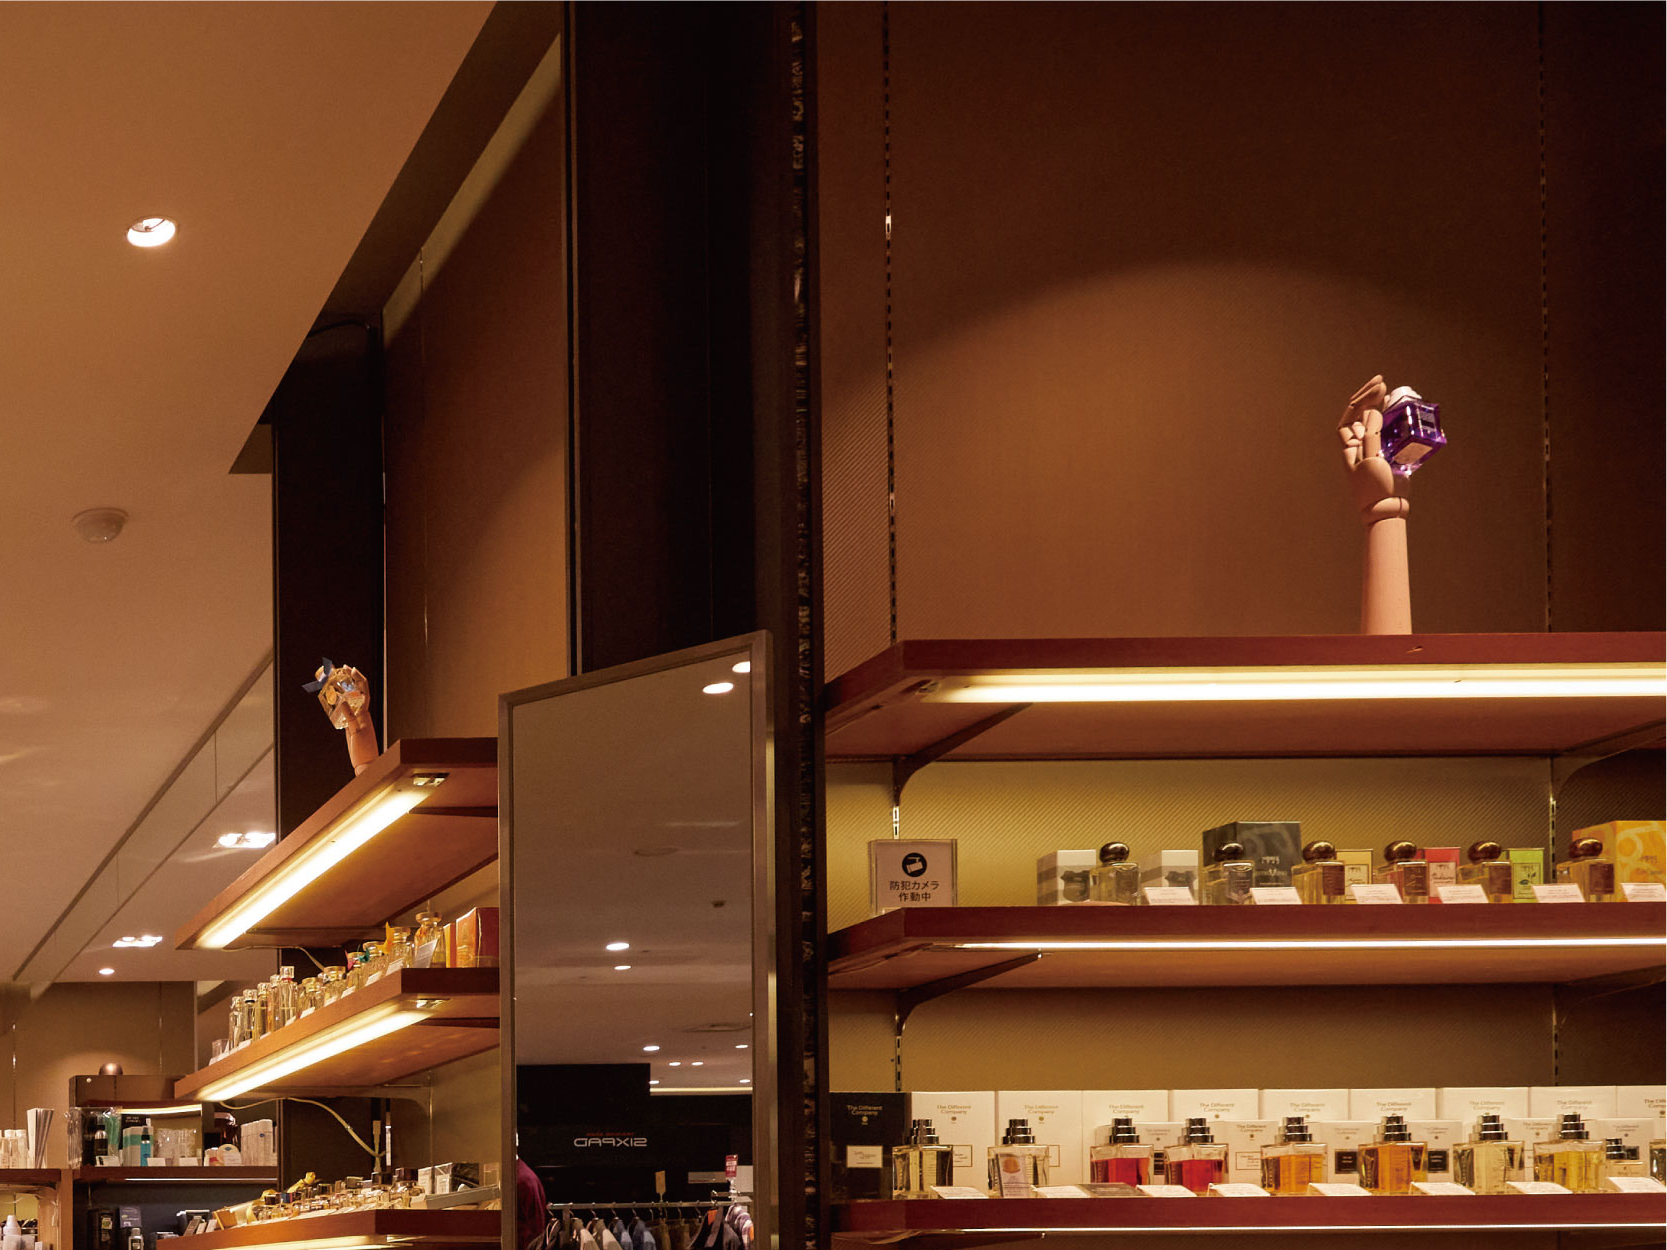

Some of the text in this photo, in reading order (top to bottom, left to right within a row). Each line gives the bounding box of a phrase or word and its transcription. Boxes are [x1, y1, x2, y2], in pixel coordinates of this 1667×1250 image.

[889, 880, 940, 891] 防犯カメラ
[899, 892, 931, 902] 作動中
